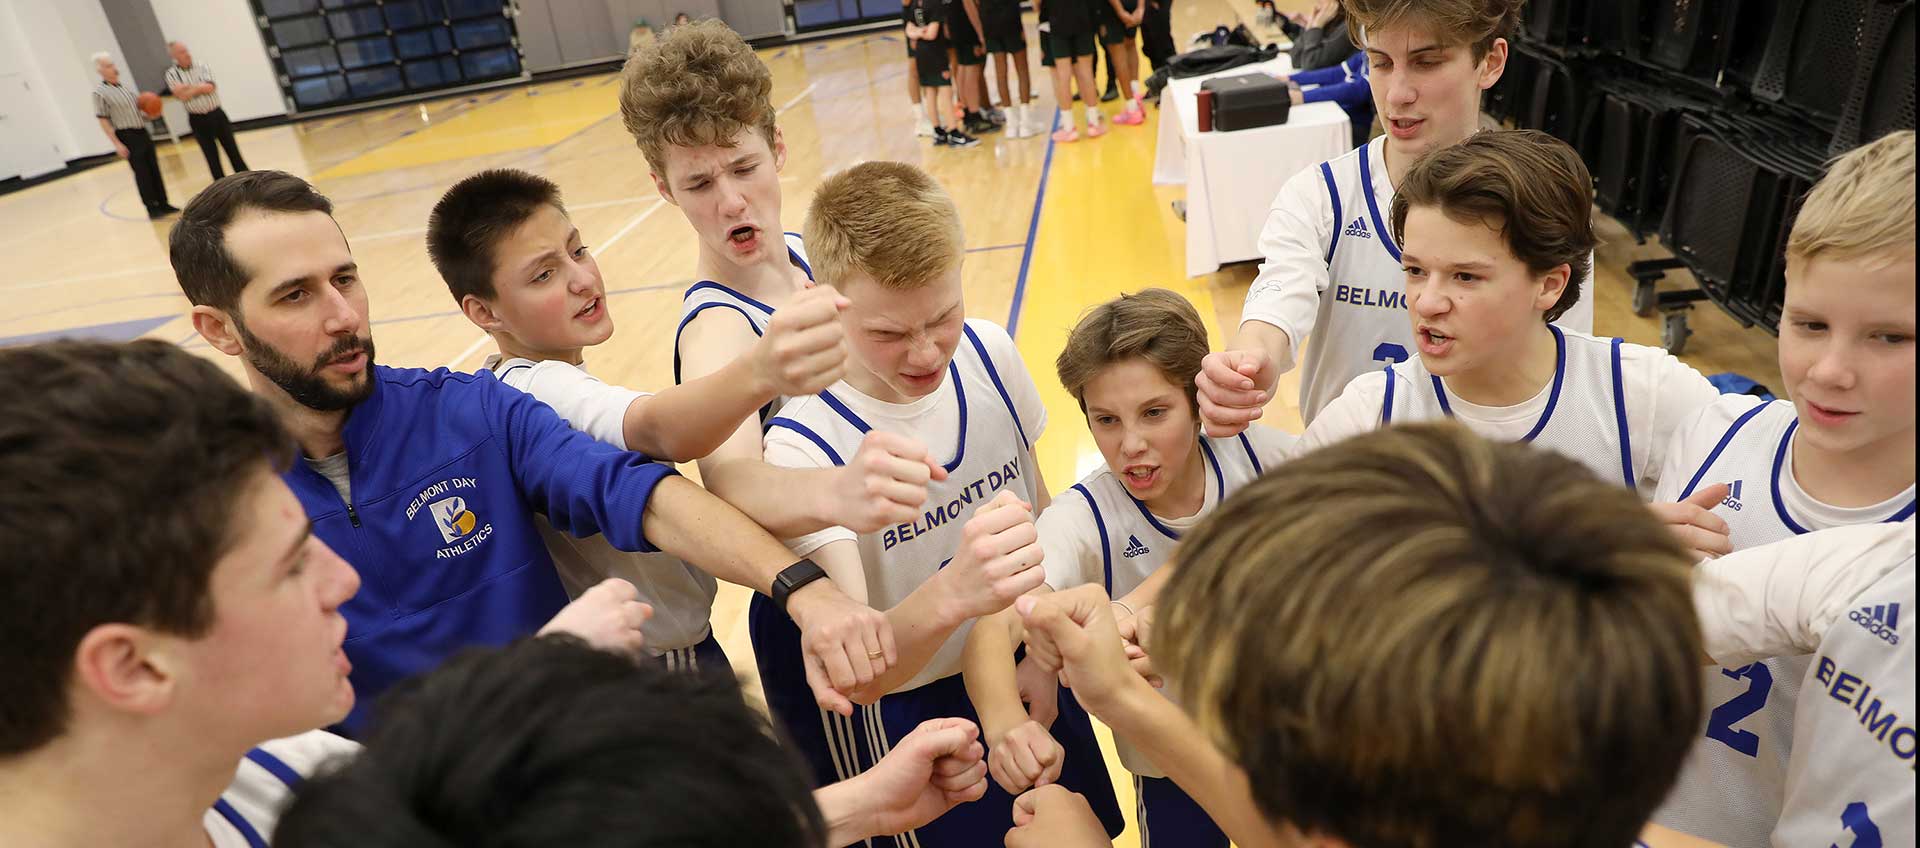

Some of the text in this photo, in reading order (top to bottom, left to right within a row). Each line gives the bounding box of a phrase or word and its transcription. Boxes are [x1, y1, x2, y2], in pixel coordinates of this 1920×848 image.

[1345, 228, 1371, 239] adidas
[406, 478, 476, 520] BELMONT DAY
[883, 456, 1020, 551] BELMONT DAY
[436, 523, 493, 558] ATHLETICS
[1849, 610, 1899, 645] adidas
[1815, 655, 1915, 768] BELMO
